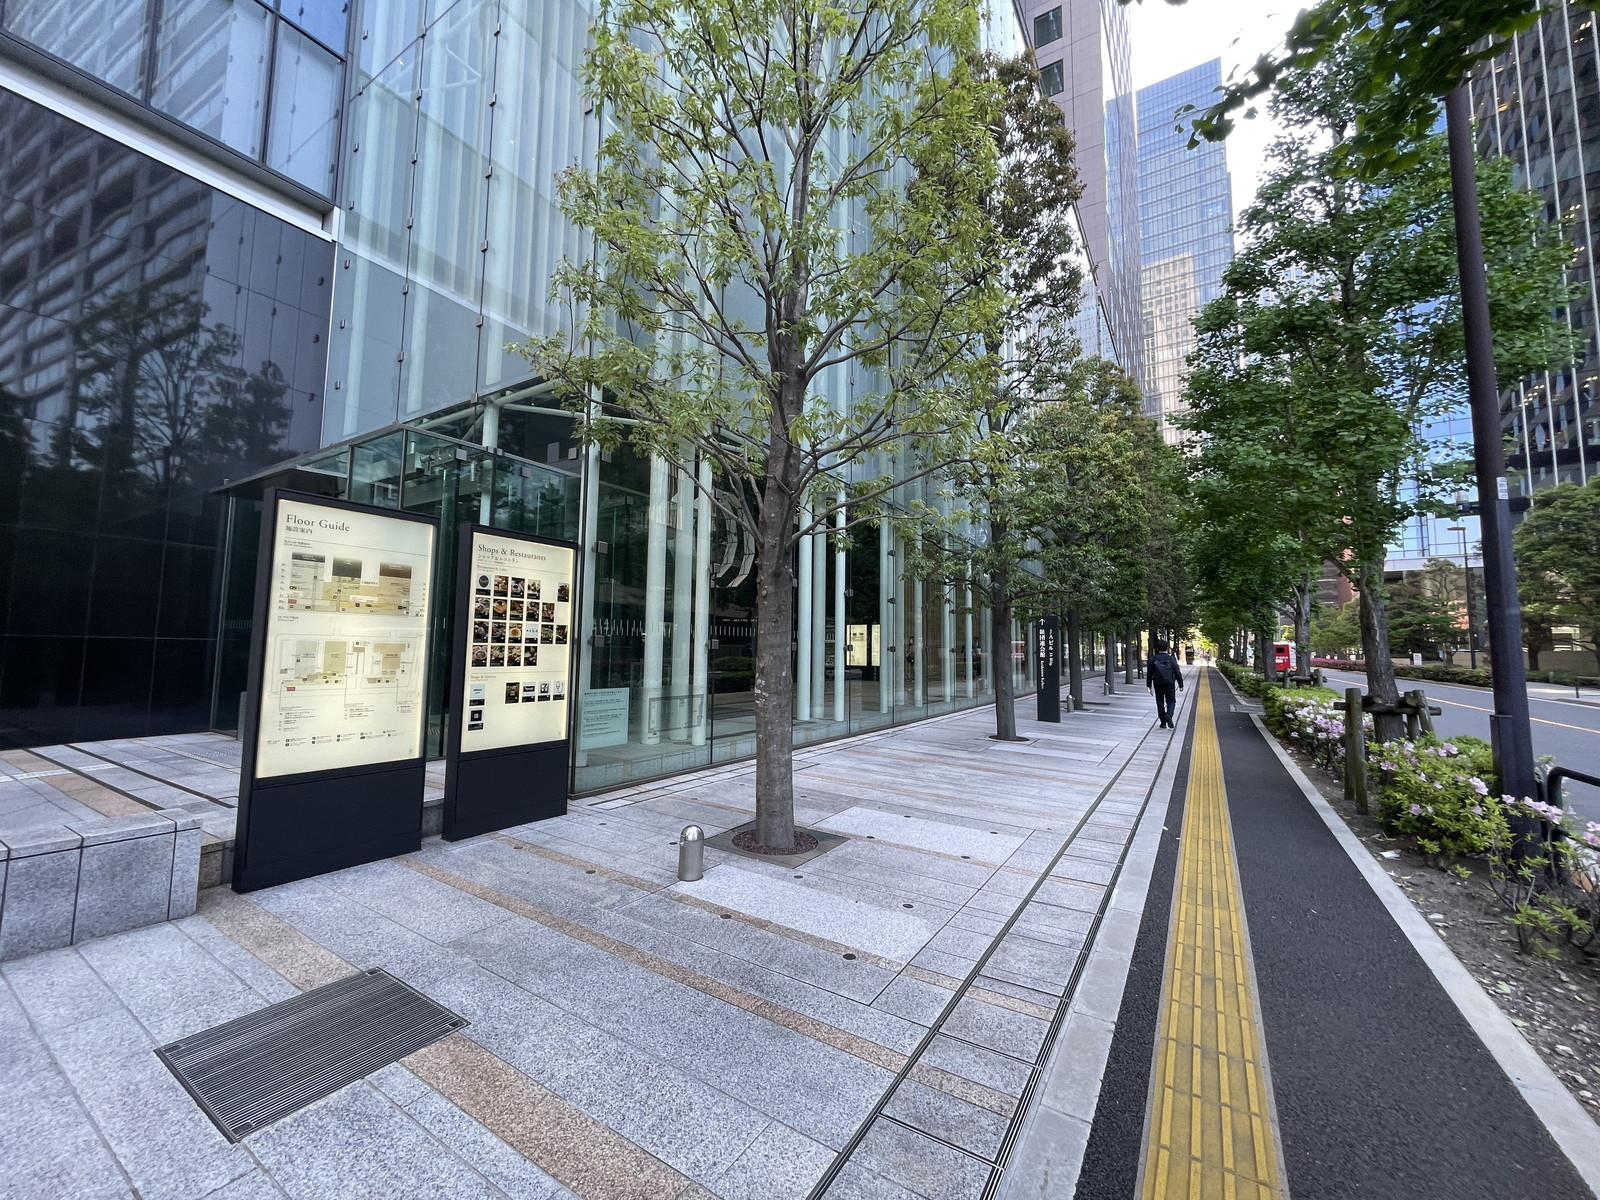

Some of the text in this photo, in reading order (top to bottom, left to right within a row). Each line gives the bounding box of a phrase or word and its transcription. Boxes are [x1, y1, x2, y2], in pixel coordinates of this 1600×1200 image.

[286, 513, 351, 532] Floor Guide
[477, 543, 499, 555] Shops
[510, 549, 547, 561] Restaurants
